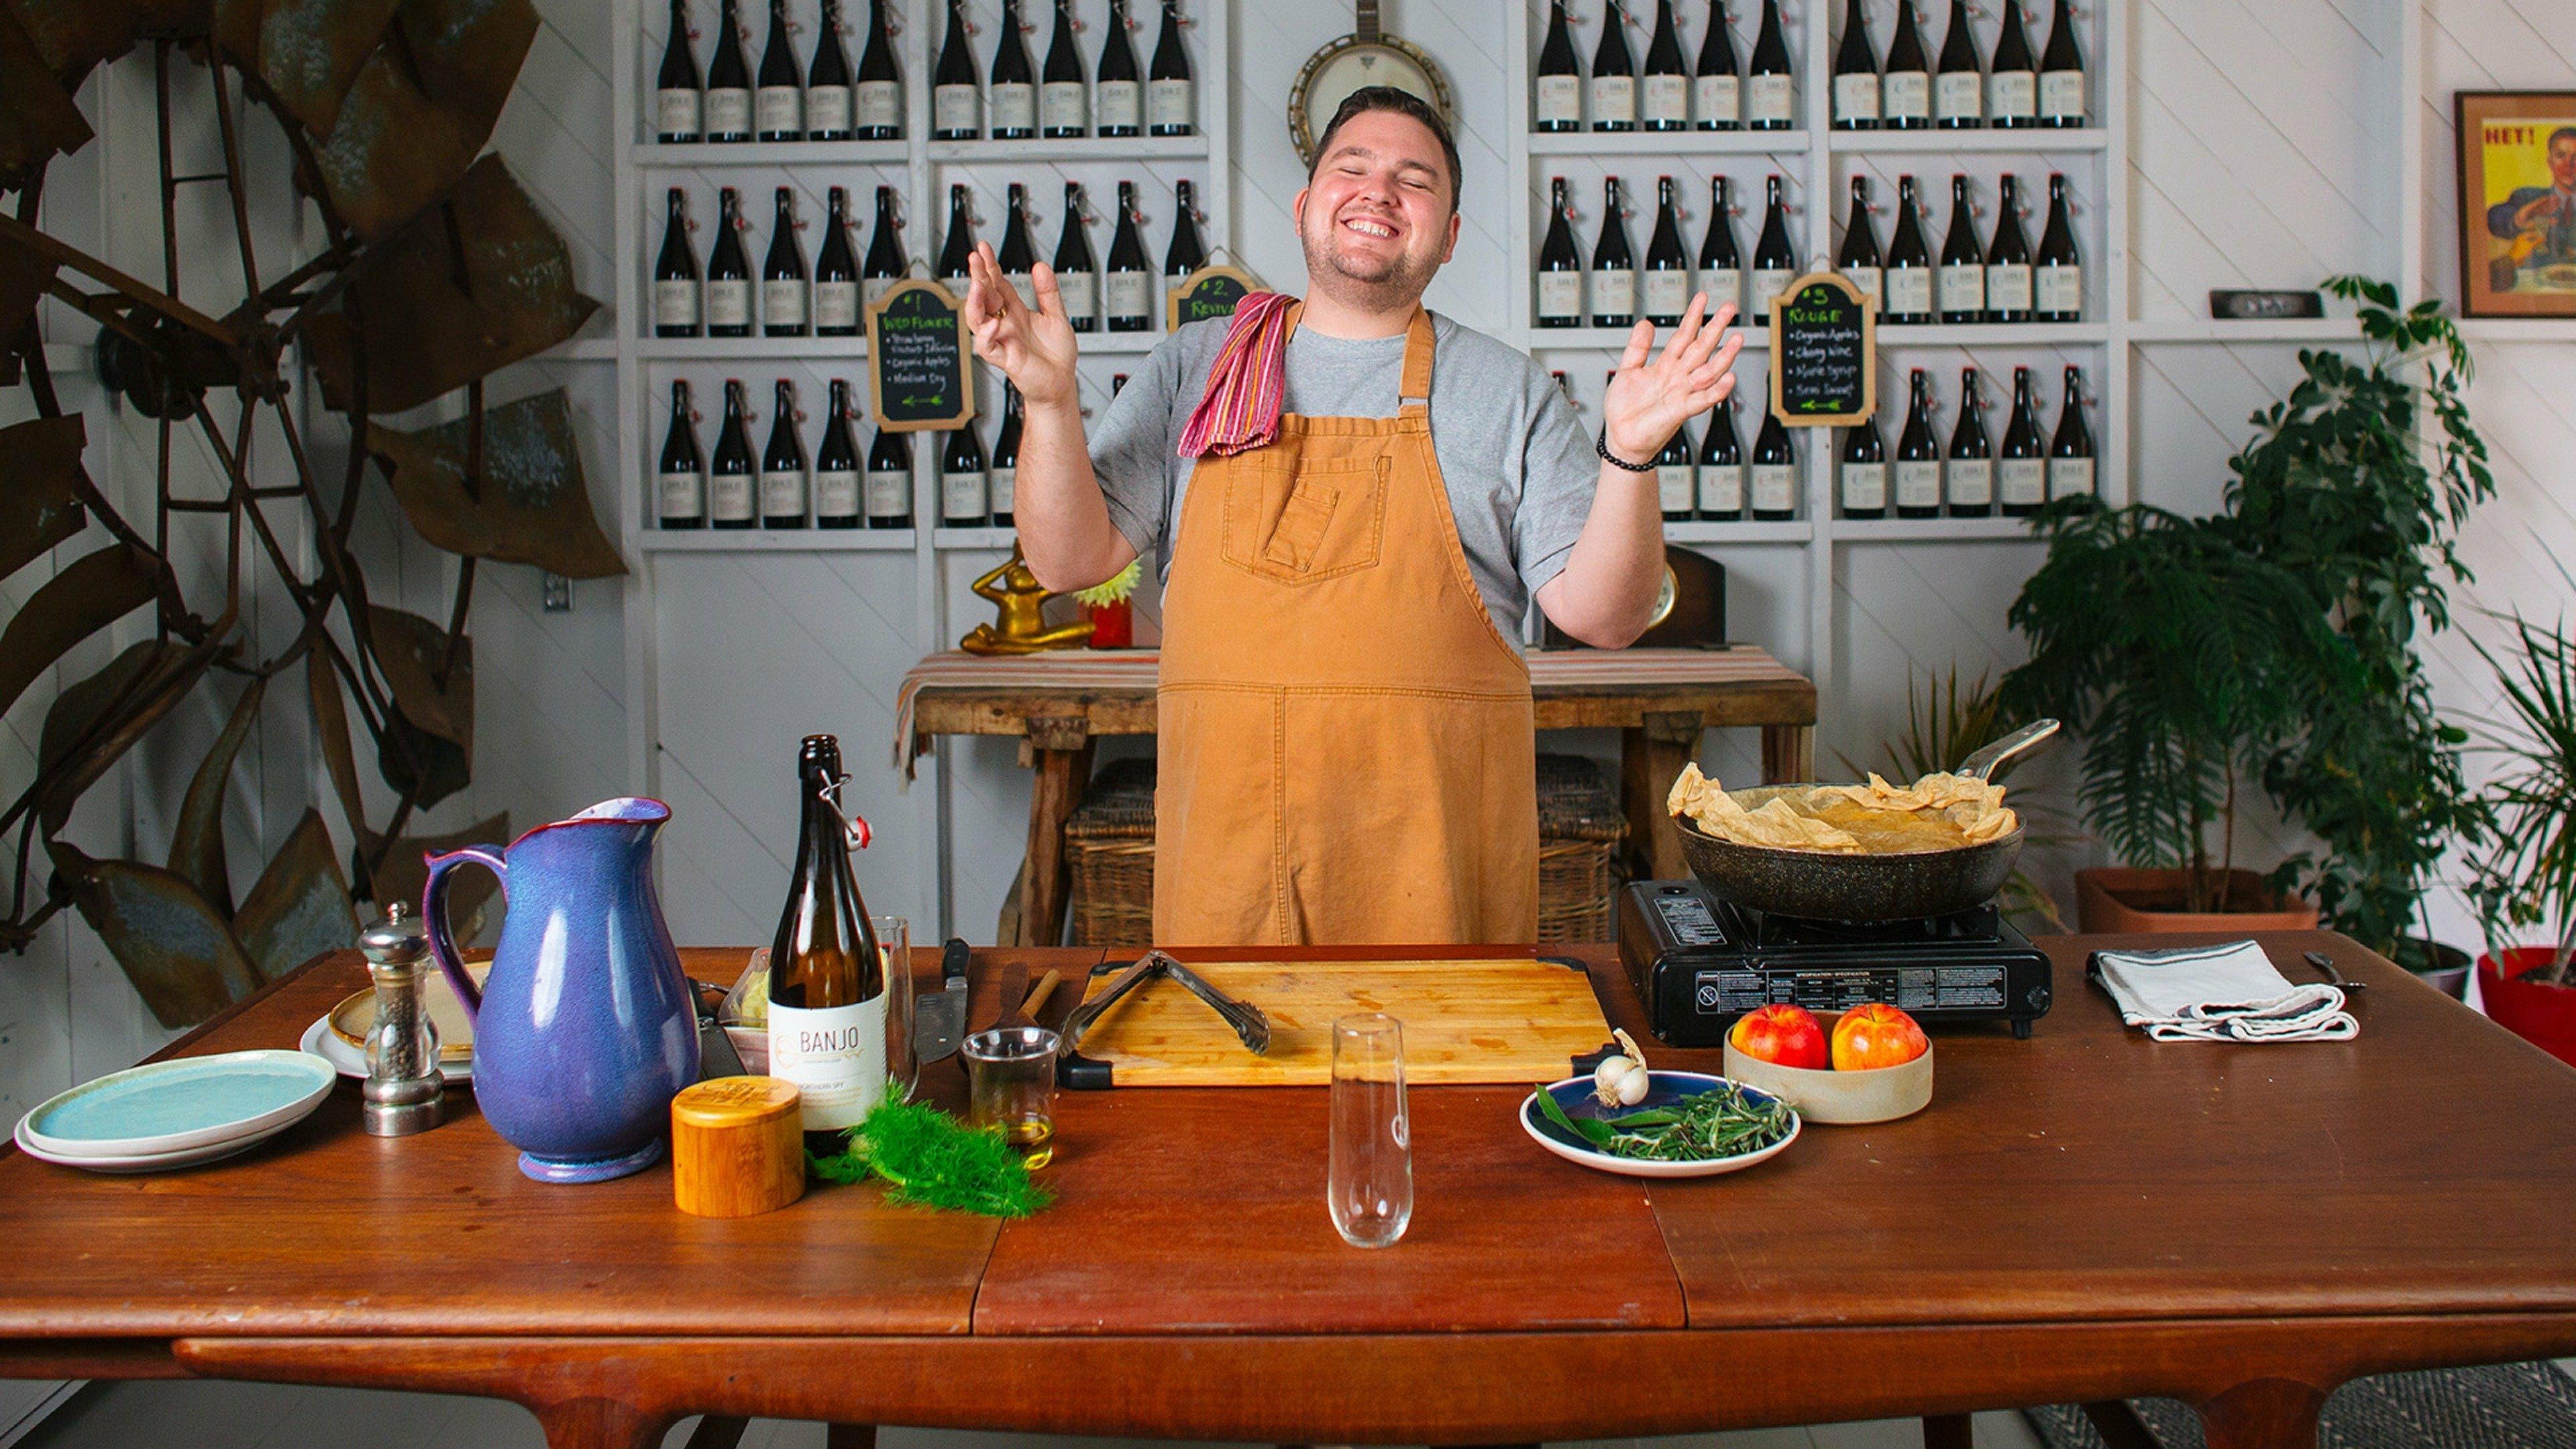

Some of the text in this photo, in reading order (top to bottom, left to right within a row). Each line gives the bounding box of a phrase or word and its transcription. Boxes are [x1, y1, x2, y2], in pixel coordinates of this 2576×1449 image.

[2485, 127, 2534, 146] HET!
[1788, 308, 1843, 325] ROUGE
[800, 1026, 859, 1053] BANJO
